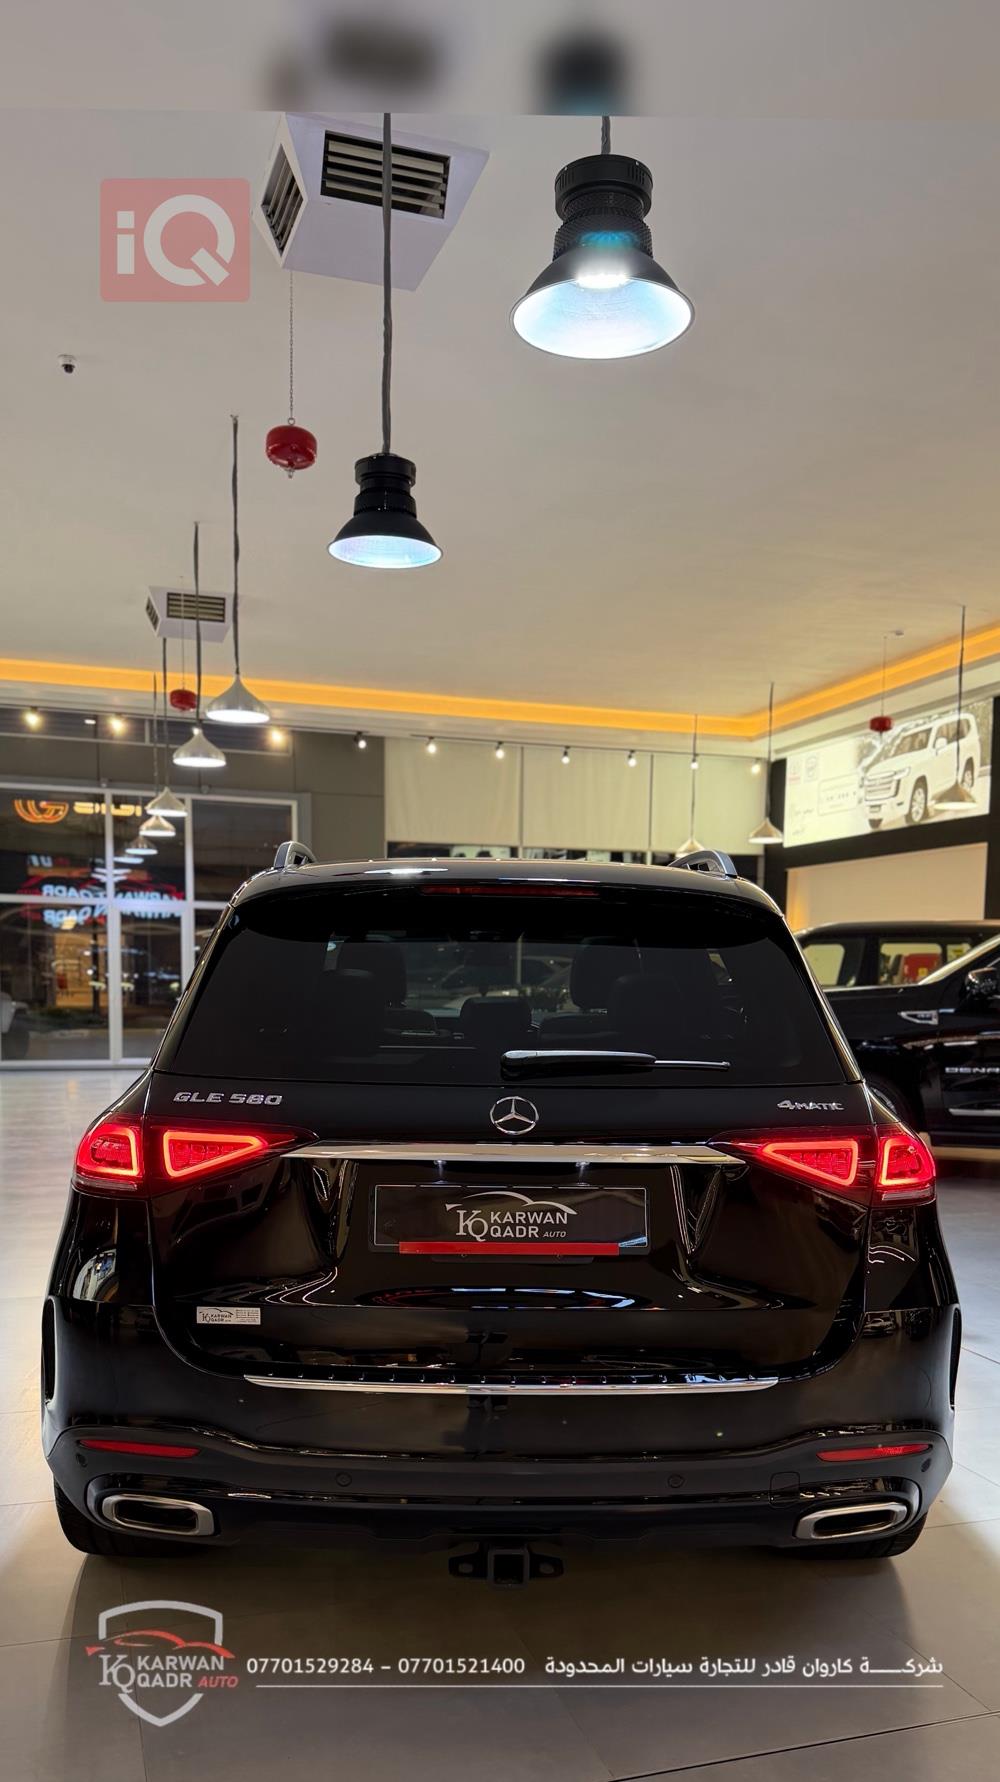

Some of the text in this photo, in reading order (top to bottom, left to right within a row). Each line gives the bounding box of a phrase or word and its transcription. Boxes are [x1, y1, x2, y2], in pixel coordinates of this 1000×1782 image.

[173, 1091, 283, 1106] GLE 580
[777, 1099, 845, 1111] 4MATIC
[489, 1211, 568, 1225] KARWAN
[489, 1225, 567, 1239] QADR AUTO
